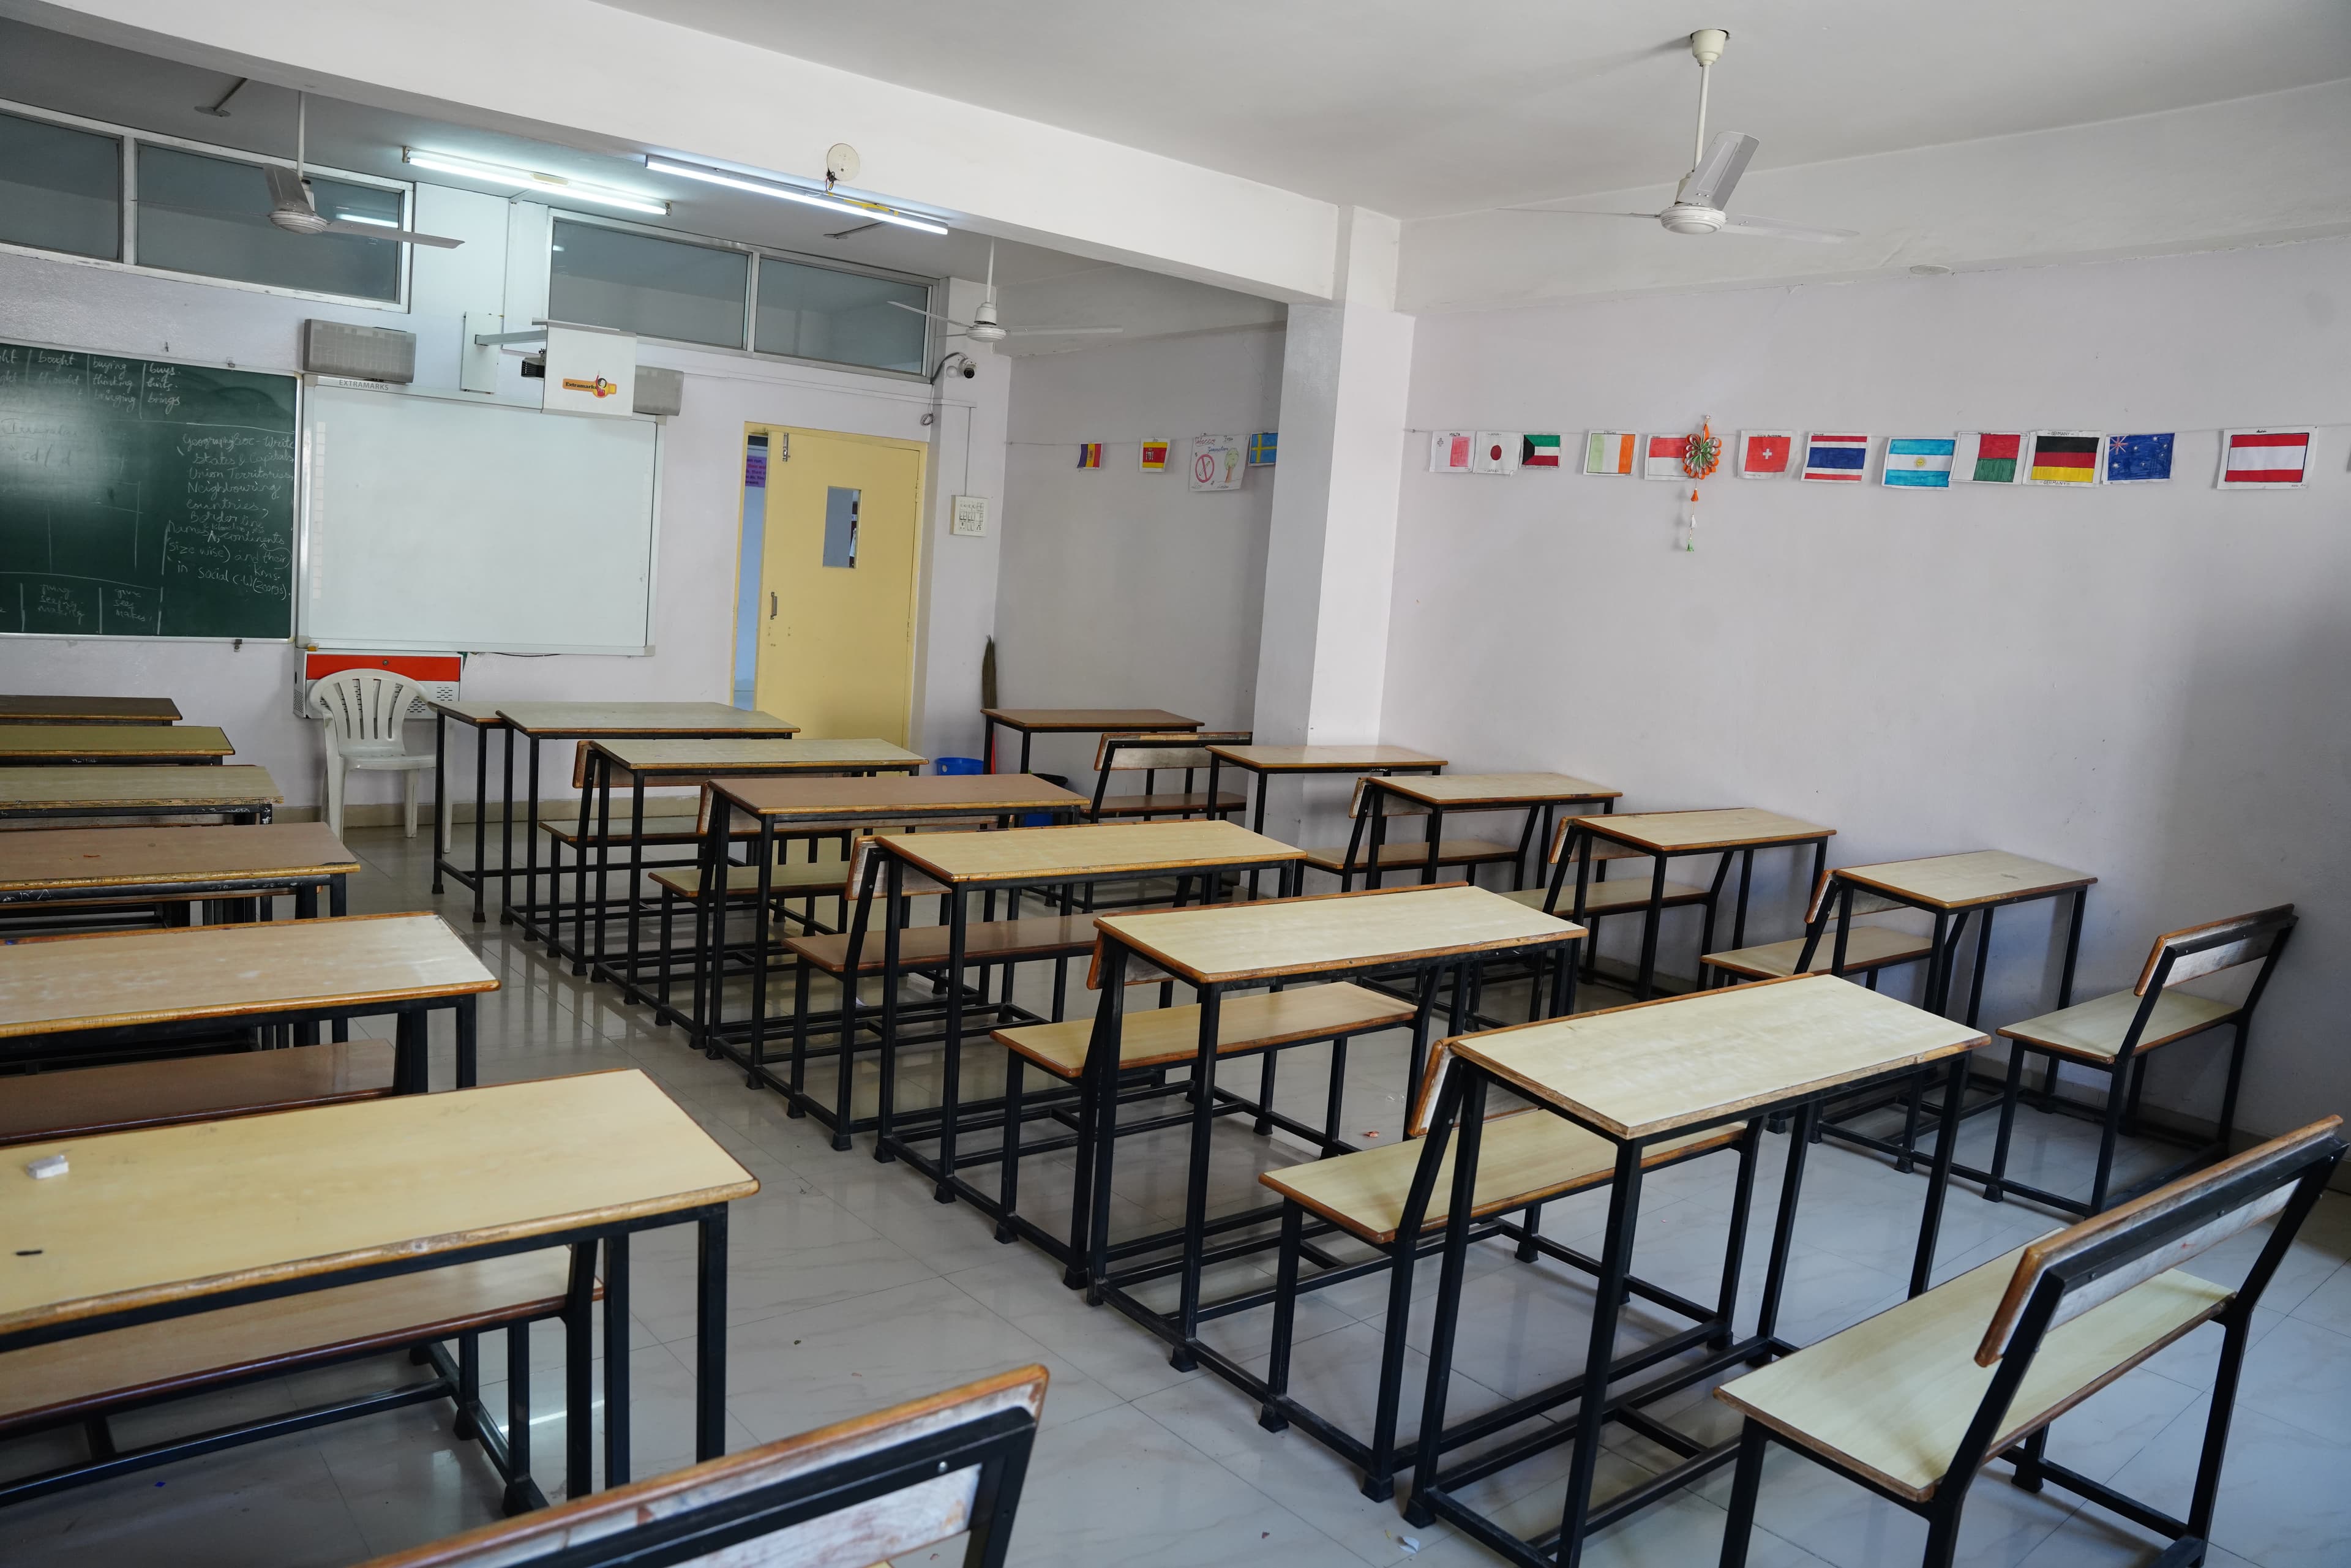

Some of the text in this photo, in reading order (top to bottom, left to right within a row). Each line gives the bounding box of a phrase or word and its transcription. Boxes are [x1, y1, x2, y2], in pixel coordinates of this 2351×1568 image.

[38, 351, 77, 372] bought
[93, 357, 127, 379] buying
[339, 379, 389, 391] EXTRAMARKS
[148, 392, 181, 415] brings
[193, 452, 235, 465] States
[189, 467, 223, 479] Union
[234, 549, 259, 564] and
[177, 560, 189, 574] in
